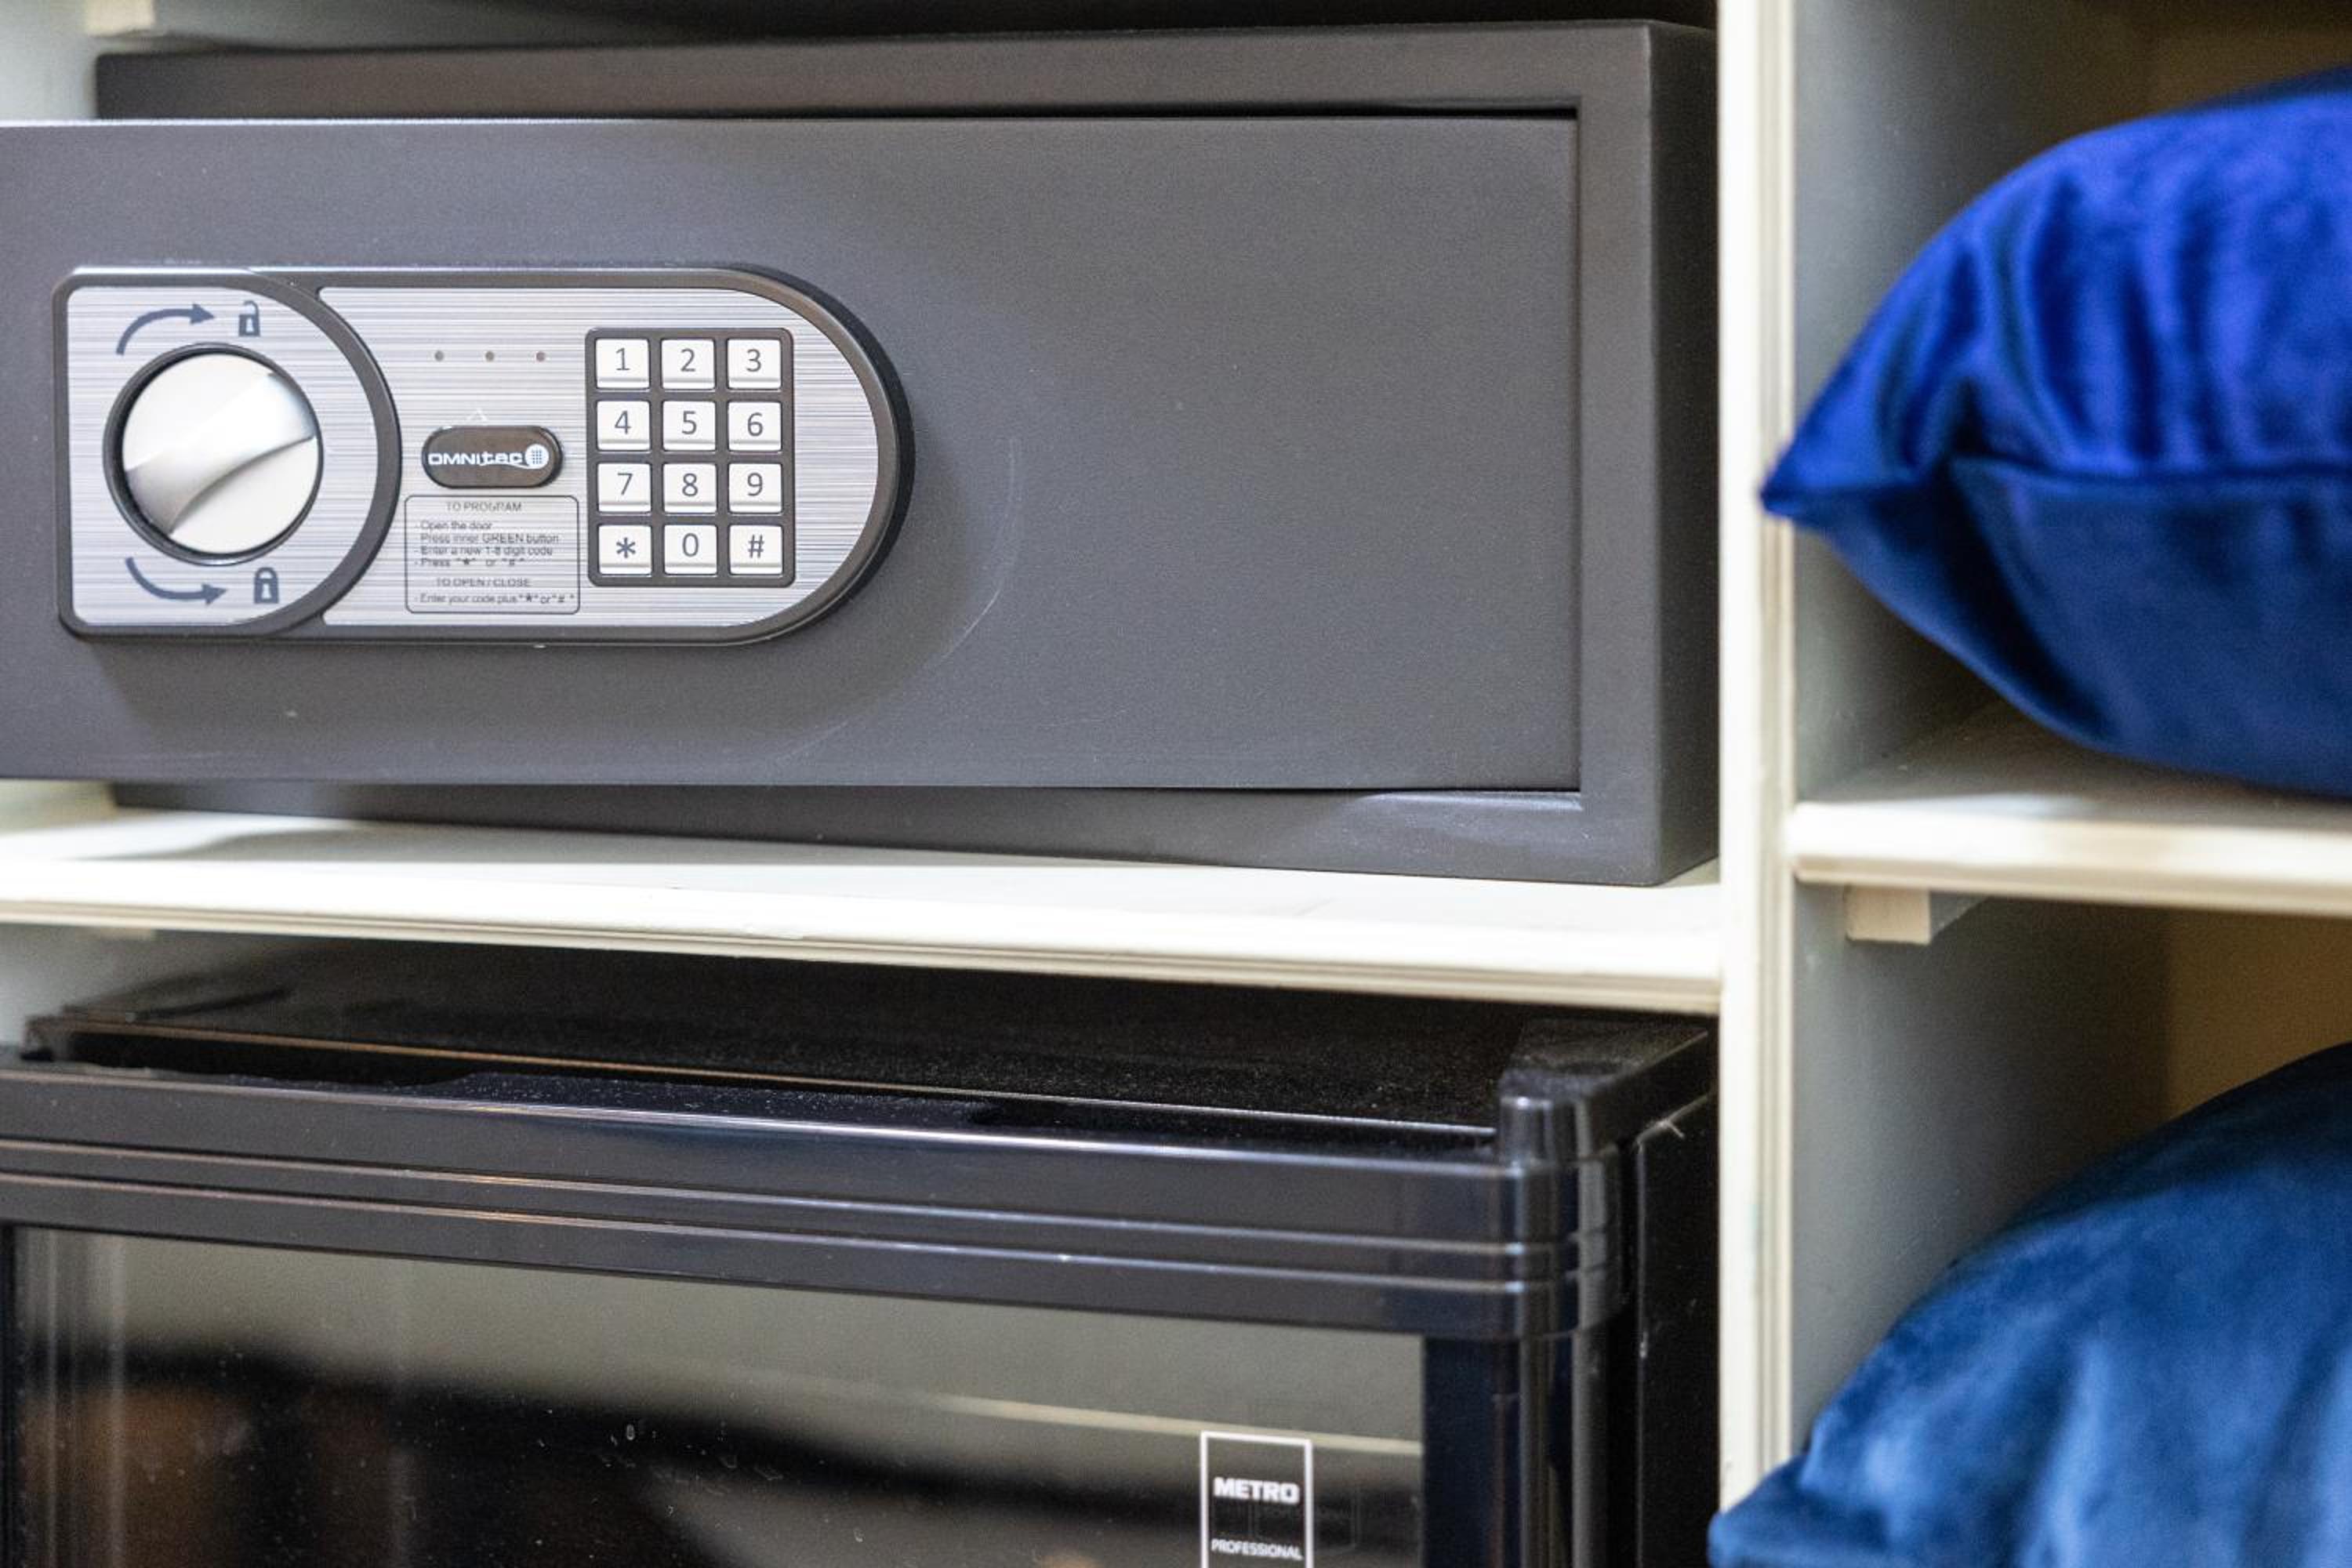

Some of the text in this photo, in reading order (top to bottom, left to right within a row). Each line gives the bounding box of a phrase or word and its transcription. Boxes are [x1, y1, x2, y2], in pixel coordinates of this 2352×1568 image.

[615, 347, 762, 372] 1 2 3
[614, 410, 764, 437] 4 5 6
[616, 472, 764, 497] 7 8 9
[445, 502, 522, 512] TO PROGRAM
[419, 521, 493, 530] Open the door
[420, 533, 451, 544] Press
[482, 533, 524, 544] GREEN
[526, 533, 559, 544] button
[681, 532, 699, 557] 0
[527, 546, 553, 556] code
[436, 579, 452, 587] TO
[453, 579, 485, 587] OPEN
[492, 579, 529, 587] CLOSE
[420, 593, 446, 603] Enter
[448, 595, 470, 605] your
[472, 594, 495, 603] code
[1214, 1476, 1301, 1505] METRO
[1210, 1537, 1304, 1562] PROFESSIONAL
